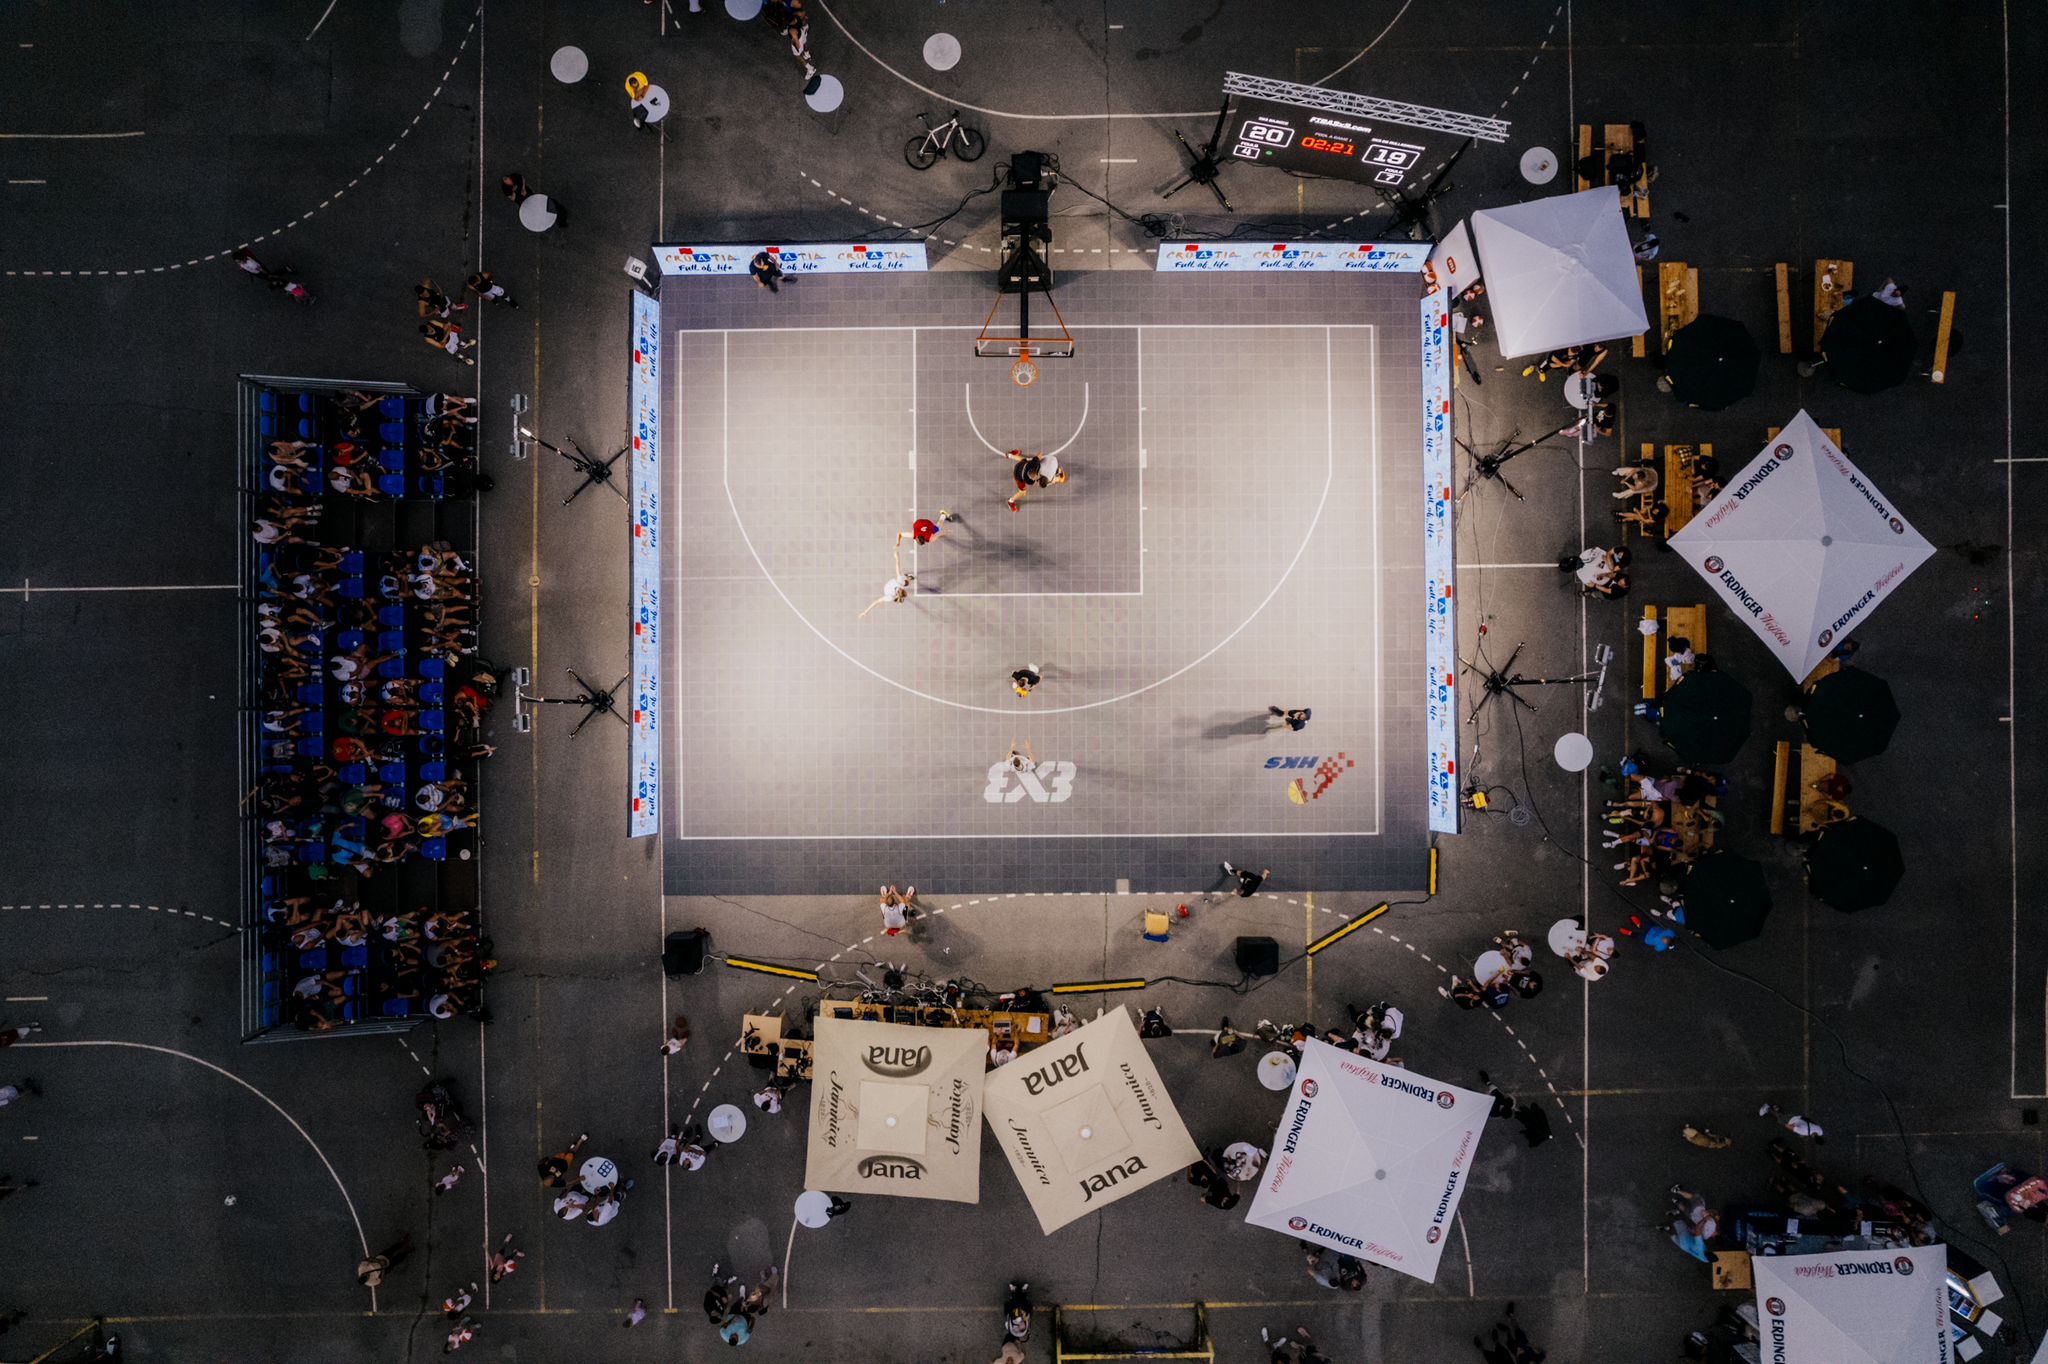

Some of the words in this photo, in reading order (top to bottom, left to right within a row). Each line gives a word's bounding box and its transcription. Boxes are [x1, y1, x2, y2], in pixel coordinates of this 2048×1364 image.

[1241, 148, 1251, 156] 4
[1249, 126, 1284, 142] 20
[1301, 136, 1355, 156] 02:21
[1373, 149, 1407, 164] 19
[1733, 458, 1780, 500] ERDINGER
[1849, 473, 1890, 520] ERDINGER
[1720, 570, 1764, 617] ERDINGER
[1832, 589, 1875, 633] ERDINGER
[869, 1045, 928, 1067] Jana
[1021, 1042, 1090, 1096] Jana
[829, 1070, 843, 1147] Jamnica
[1120, 1062, 1163, 1130] Jamnica
[1380, 1073, 1434, 1102] ERDINGER
[946, 1079, 962, 1155] Jamnica
[1283, 1099, 1312, 1154] ERDINGER
[862, 1161, 921, 1180] Jana
[1008, 1118, 1051, 1185] Jamnica
[1079, 1155, 1148, 1202] Jana
[1433, 1170, 1460, 1224] ERDINGER
[1309, 1223, 1364, 1250] ERDINGER
[1835, 1261, 1894, 1276] ERDINGER
[1772, 1319, 1785, 1364] ERDING
